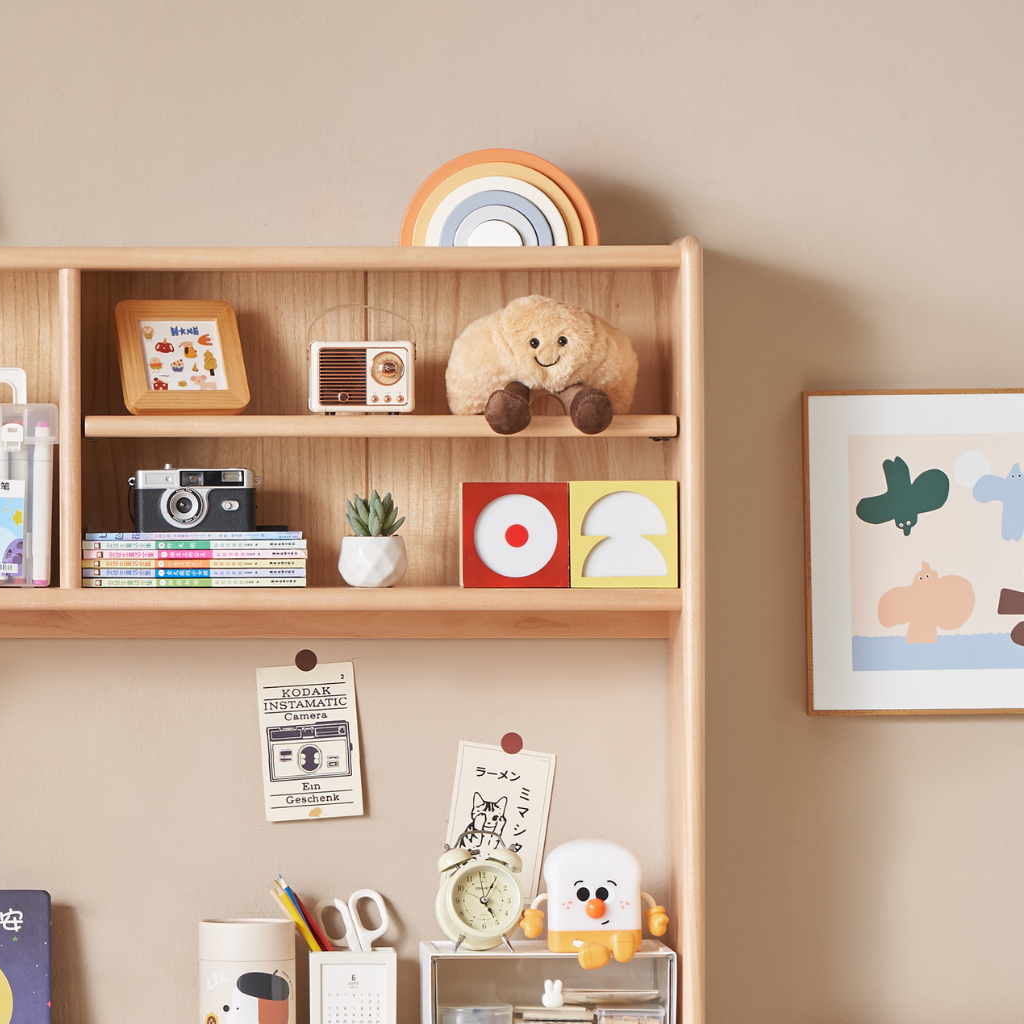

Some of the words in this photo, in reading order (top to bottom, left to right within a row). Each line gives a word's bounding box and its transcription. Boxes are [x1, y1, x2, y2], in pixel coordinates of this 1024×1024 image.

[282, 686, 331, 698] KODAK
[264, 697, 348, 711] INSTAMATIC
[284, 712, 328, 721] Camera
[475, 766, 521, 782] ラーメン
[302, 782, 321, 791] Ein
[286, 793, 340, 804] Geschenk
